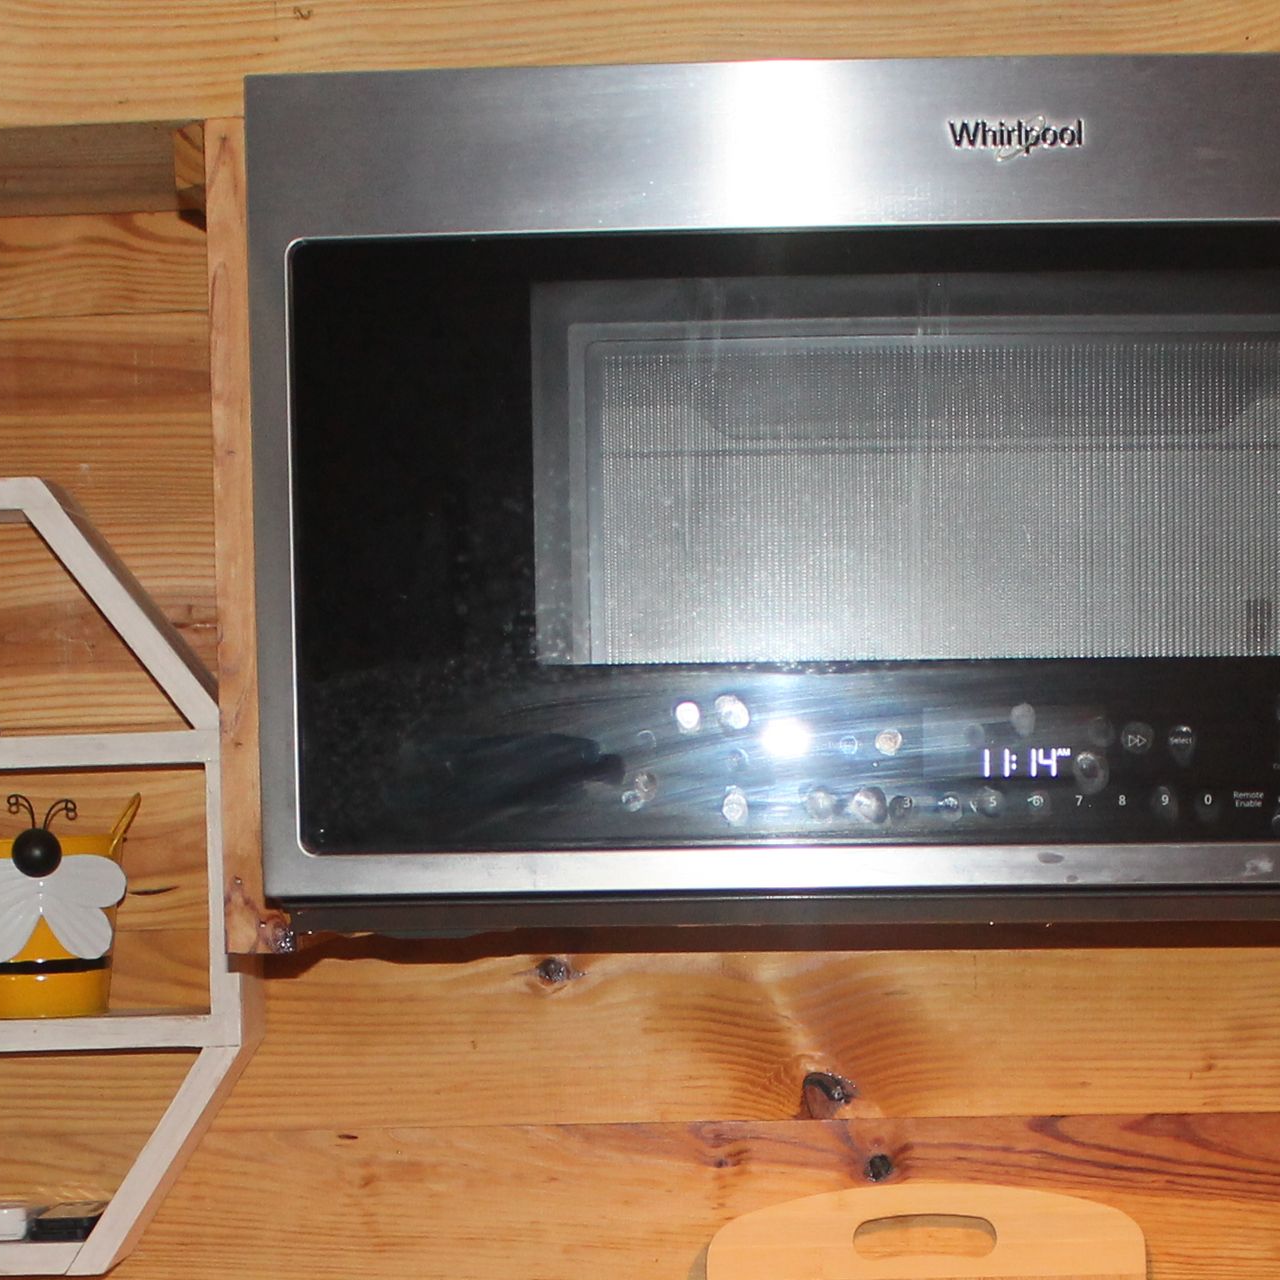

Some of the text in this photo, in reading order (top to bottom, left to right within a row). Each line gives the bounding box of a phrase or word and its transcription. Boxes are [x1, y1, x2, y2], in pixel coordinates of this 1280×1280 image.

[949, 119, 1084, 155] Whirlpool
[982, 747, 1071, 778] 11:14 AM
[903, 796, 911, 809] 3
[989, 795, 997, 807] 5
[1075, 794, 1084, 807] 7
[1118, 794, 1127, 806] 8
[1161, 794, 1170, 806] 9
[1204, 794, 1213, 805] 0
[1233, 790, 1265, 800] Remote
[1235, 800, 1262, 808] Enable
